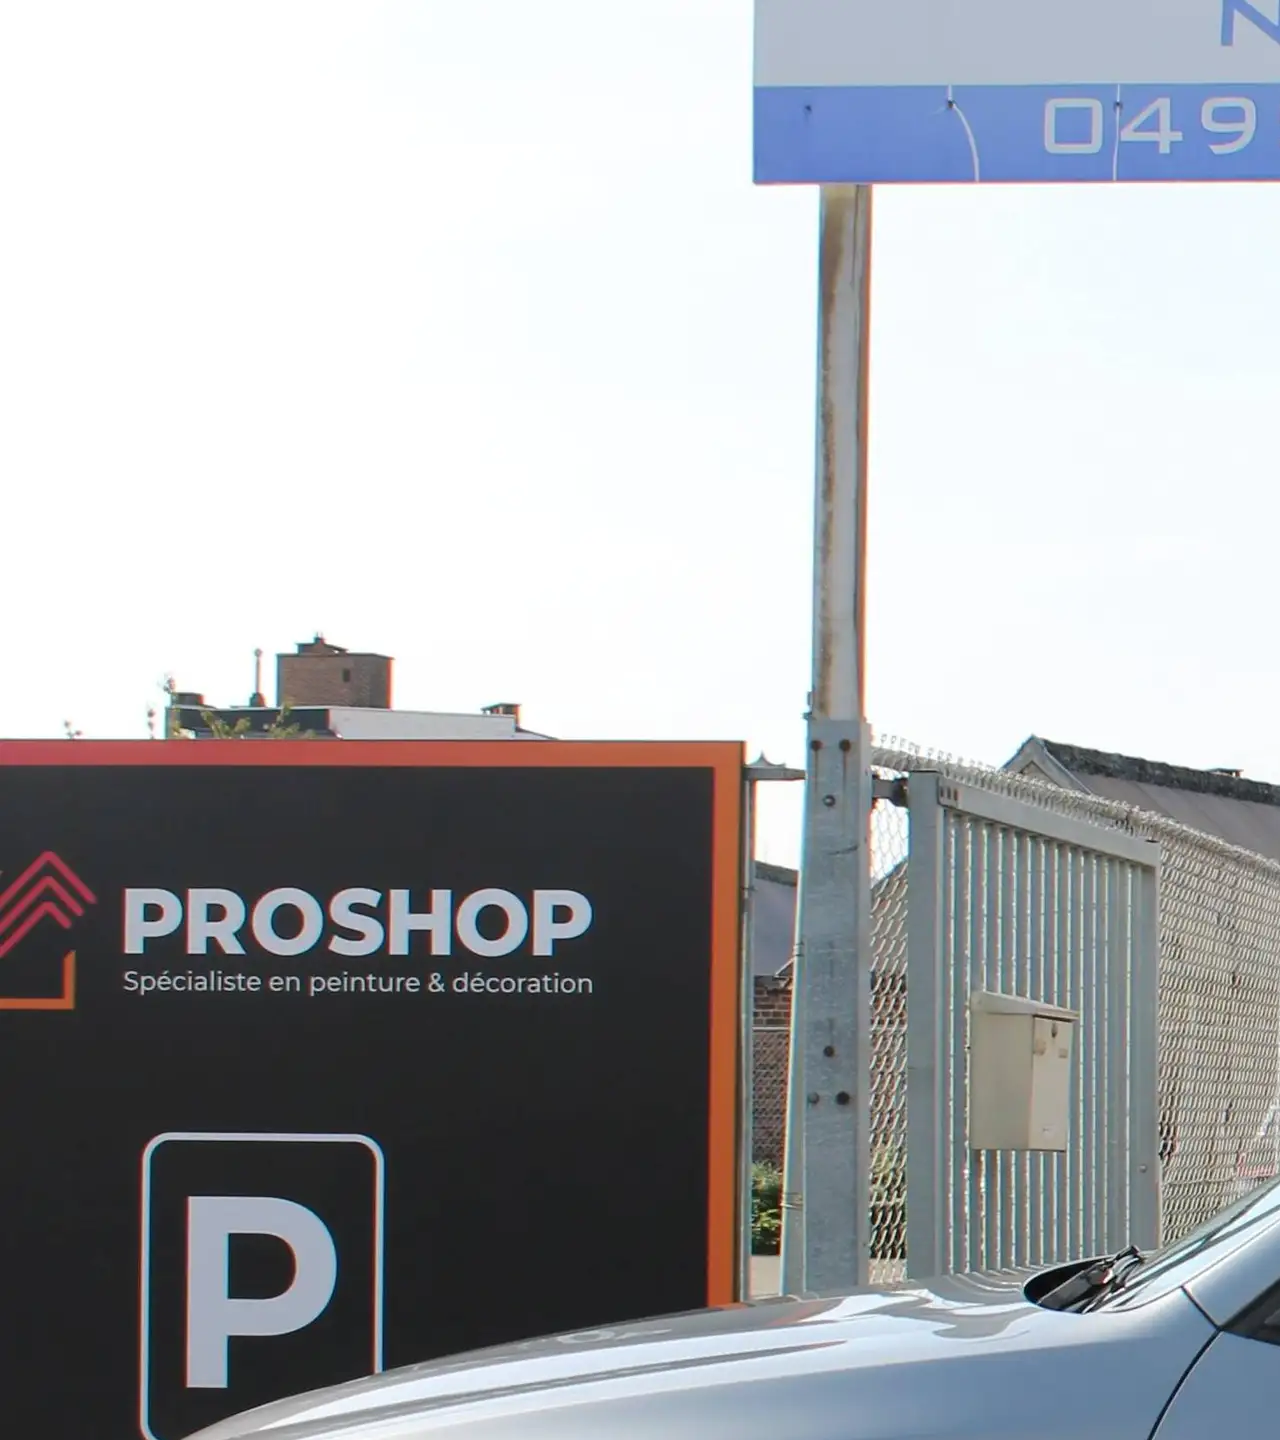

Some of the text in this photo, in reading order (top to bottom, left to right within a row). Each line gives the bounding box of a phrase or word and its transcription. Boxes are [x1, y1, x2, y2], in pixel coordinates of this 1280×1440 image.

[123, 886, 593, 957] PROSHOP
[123, 969, 593, 997] Spécialiste en peinture & décoration
[185, 1195, 338, 1389] P
